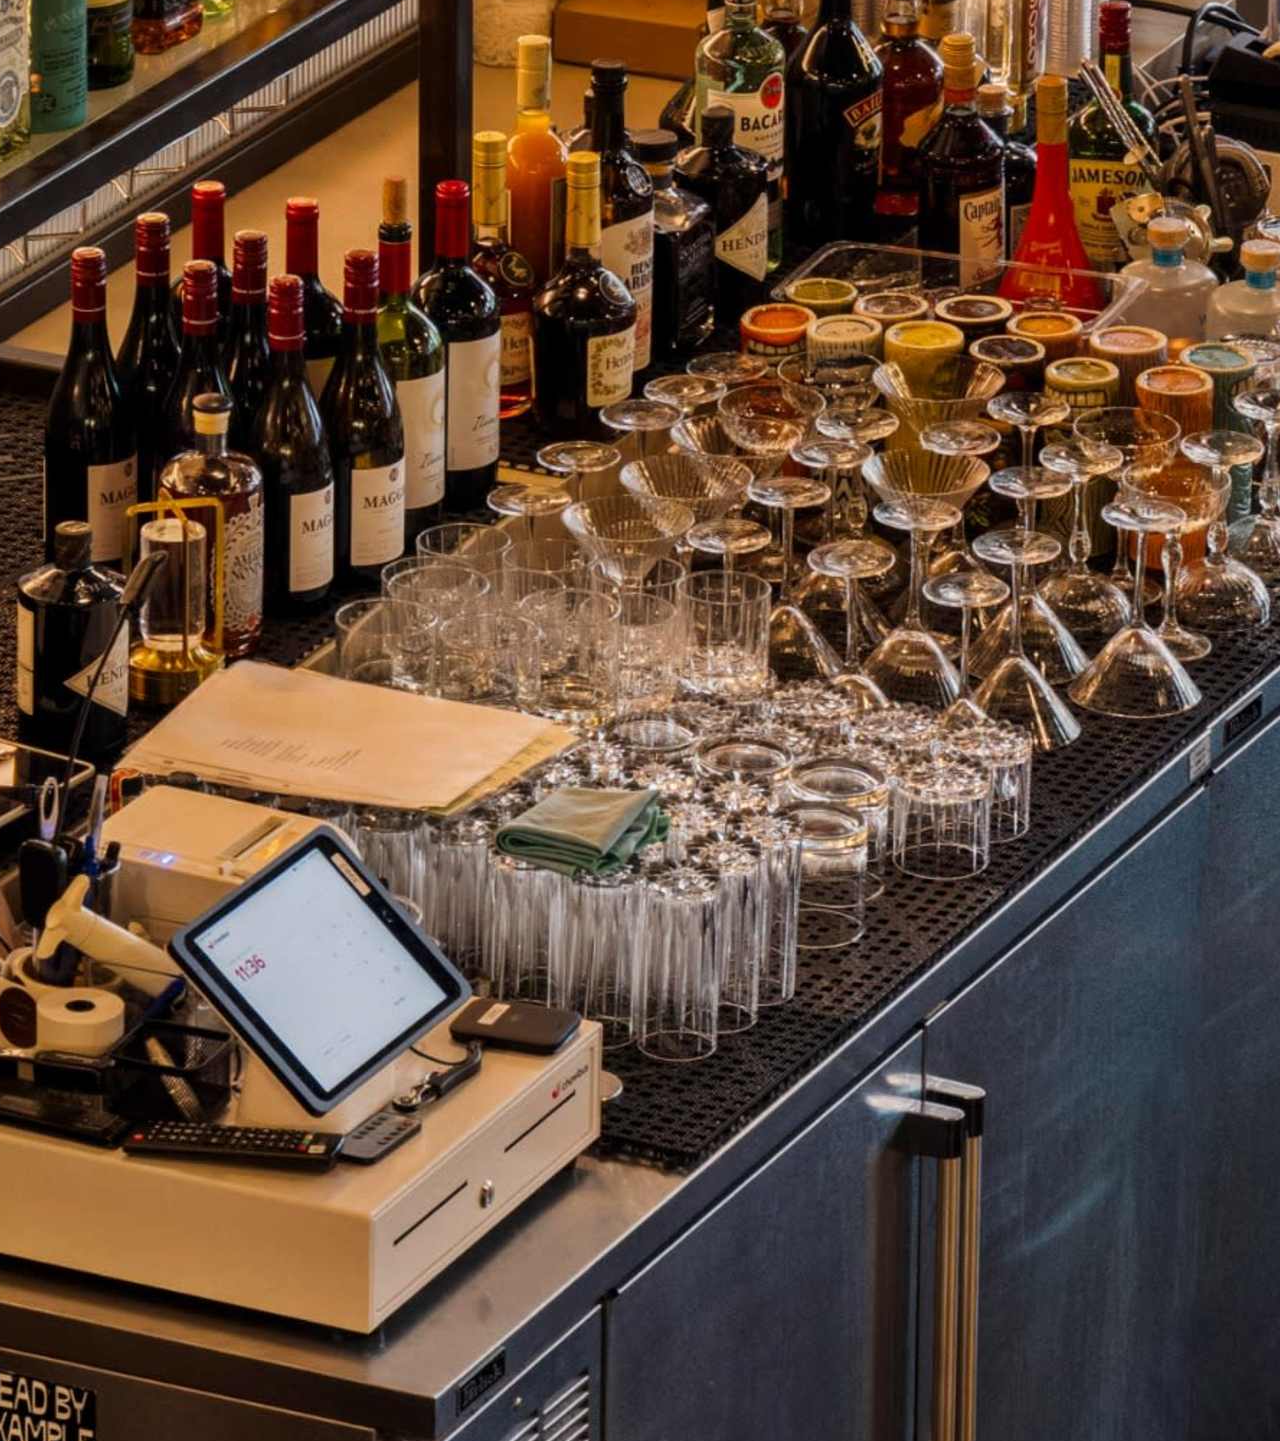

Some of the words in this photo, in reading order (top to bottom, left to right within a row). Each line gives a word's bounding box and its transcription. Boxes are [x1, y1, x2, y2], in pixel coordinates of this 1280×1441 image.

[1071, 166, 1148, 187] JAMESON
[233, 954, 267, 982] 11:36
[55, 1385, 89, 1424] BY
